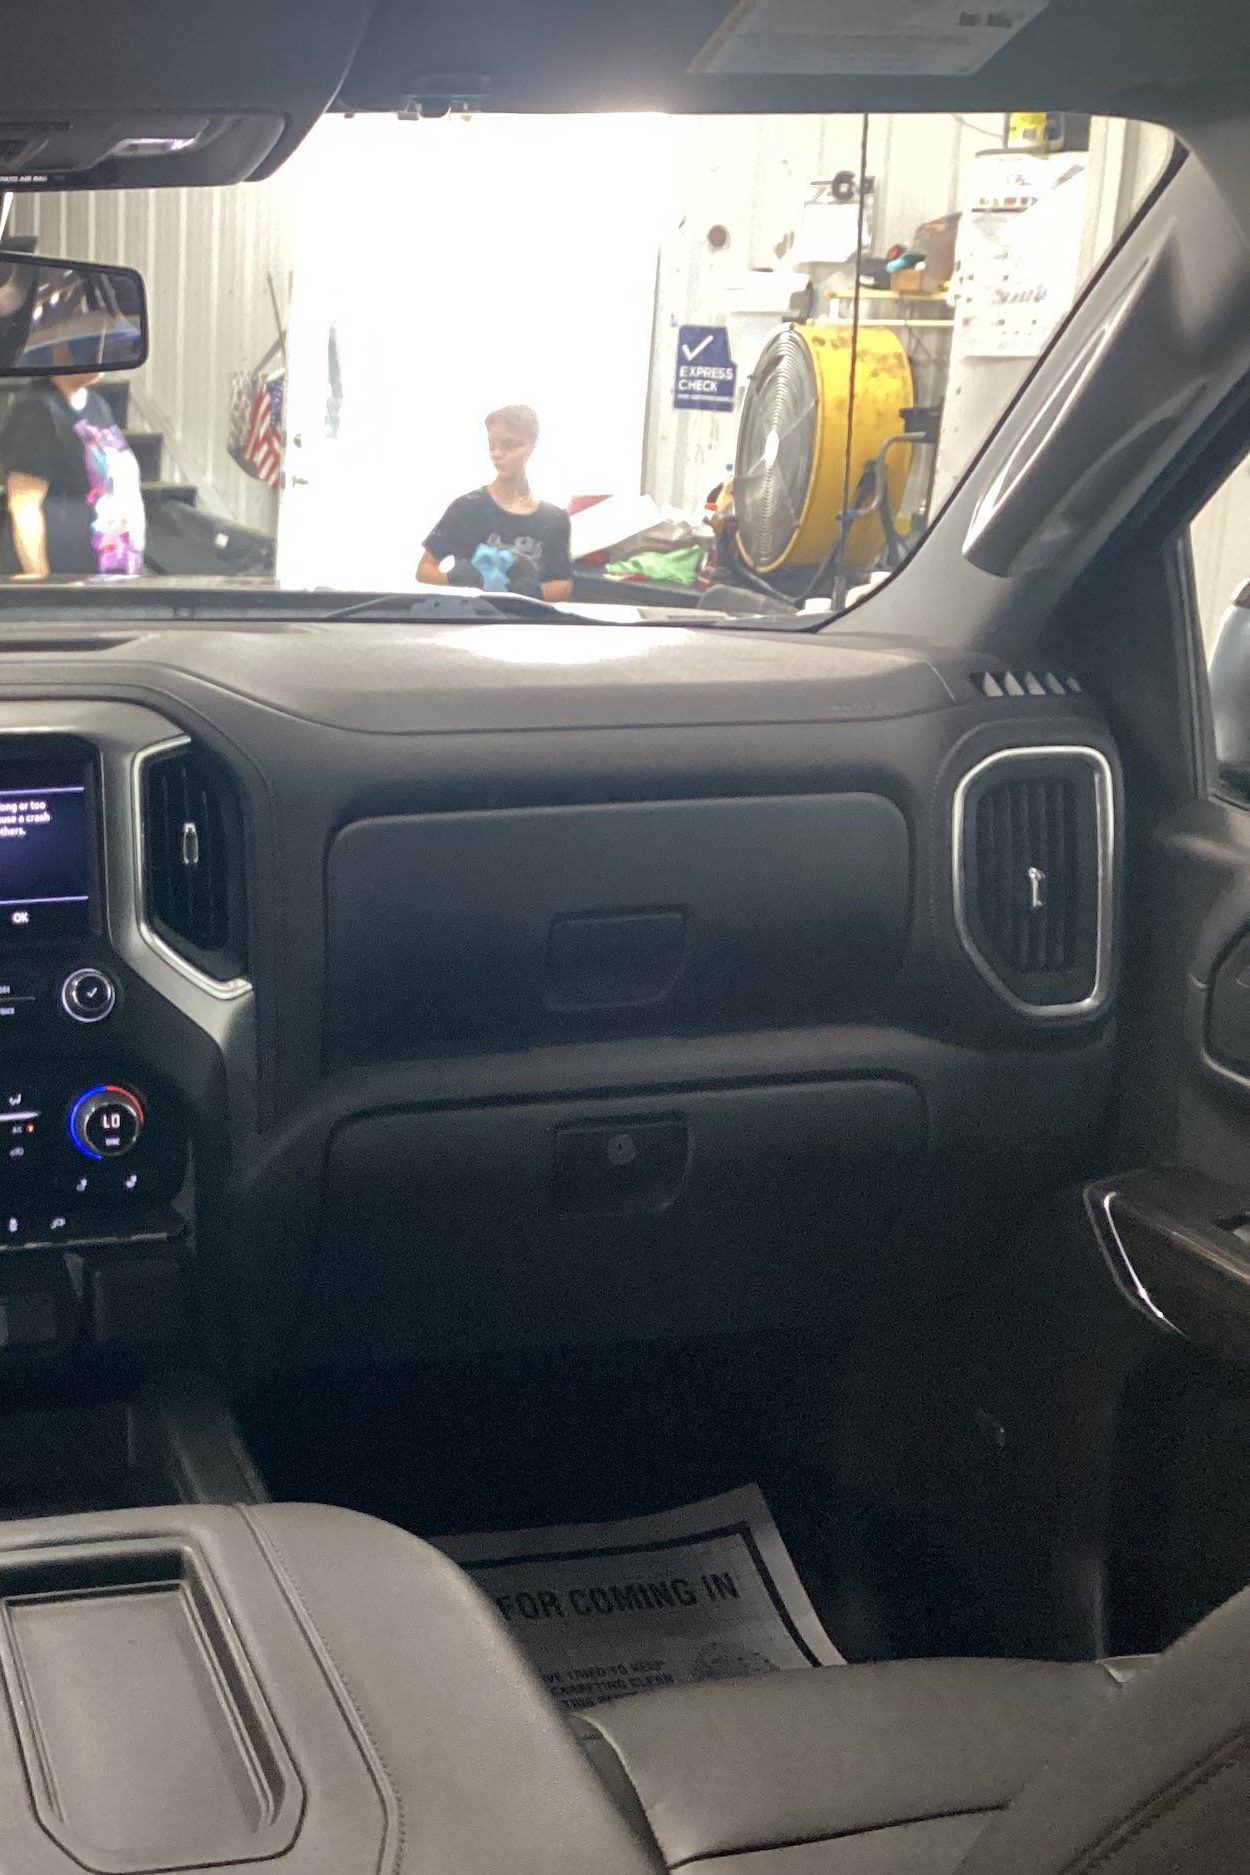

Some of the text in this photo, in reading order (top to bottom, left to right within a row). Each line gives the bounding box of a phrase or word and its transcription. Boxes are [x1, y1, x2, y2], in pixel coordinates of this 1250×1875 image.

[680, 366, 734, 380] EXPRESS
[678, 379, 718, 392] CHECK
[19, 803, 28, 811] or
[30, 801, 46, 810] too
[26, 811, 50, 823] crash
[12, 912, 29, 924] OK
[103, 1113, 120, 1128] LO
[496, 1572, 740, 1621] FOR COMING IN
[609, 1664, 628, 1675] TO
